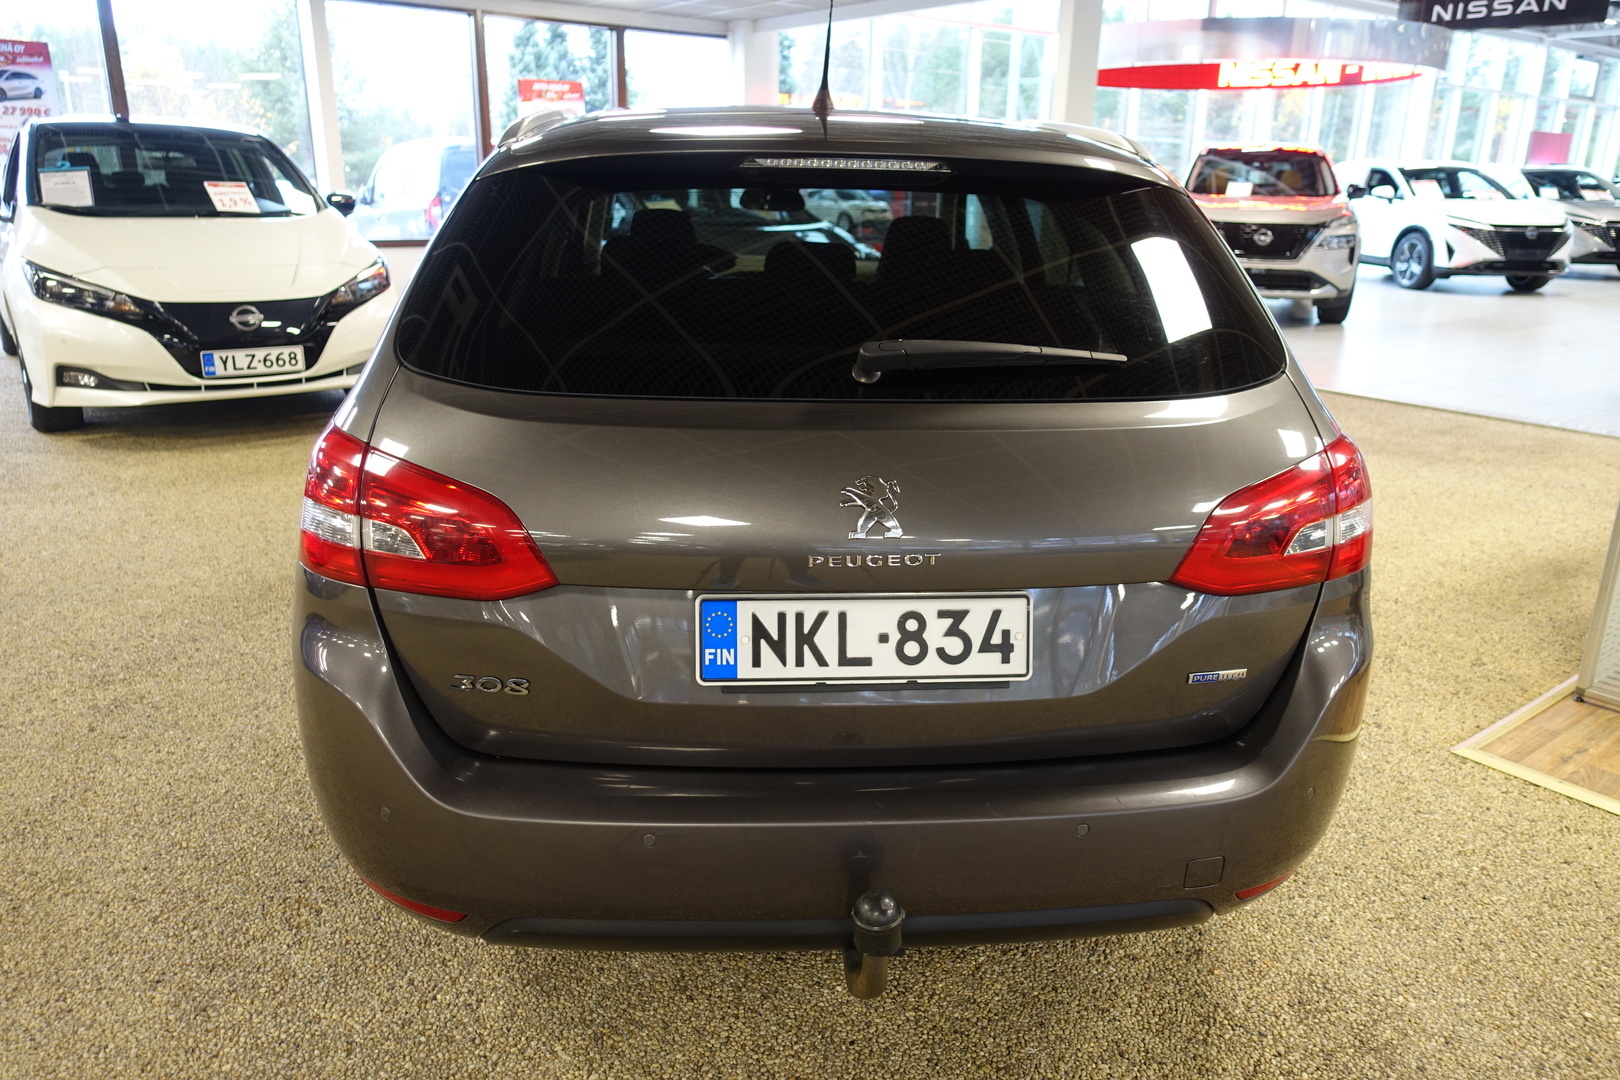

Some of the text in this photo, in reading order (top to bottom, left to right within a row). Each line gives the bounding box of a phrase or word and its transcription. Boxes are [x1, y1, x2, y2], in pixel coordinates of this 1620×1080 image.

[1431, 0, 1568, 23] NISSAN
[1218, 62, 1342, 88] NISSAN
[2, 106, 17, 115] 27
[19, 107, 42, 116] 990
[219, 351, 299, 371] YLZ-668
[808, 553, 941, 568] PEUGEOT
[704, 608, 1015, 668] FIN NKL-834
[450, 674, 530, 695] 308
